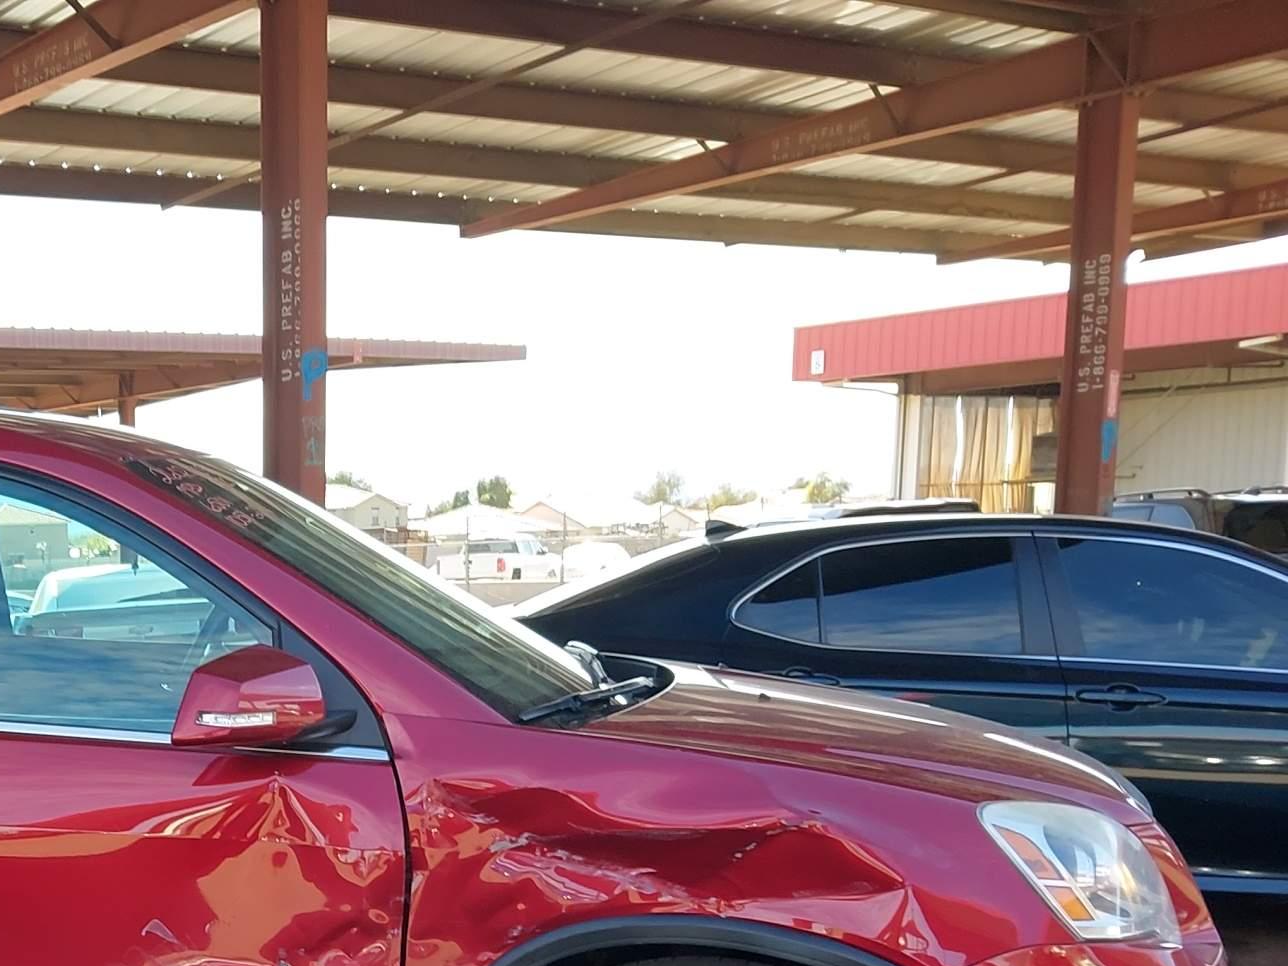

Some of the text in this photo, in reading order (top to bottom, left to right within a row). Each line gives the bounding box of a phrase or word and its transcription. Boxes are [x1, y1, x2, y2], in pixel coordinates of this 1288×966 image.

[281, 198, 293, 382] U.S. PREFAB INC.
[1079, 293, 1095, 354] PREFAB
[1092, 253, 1111, 391] 1-866-799-0969
[1077, 362, 1091, 393] U.S.
